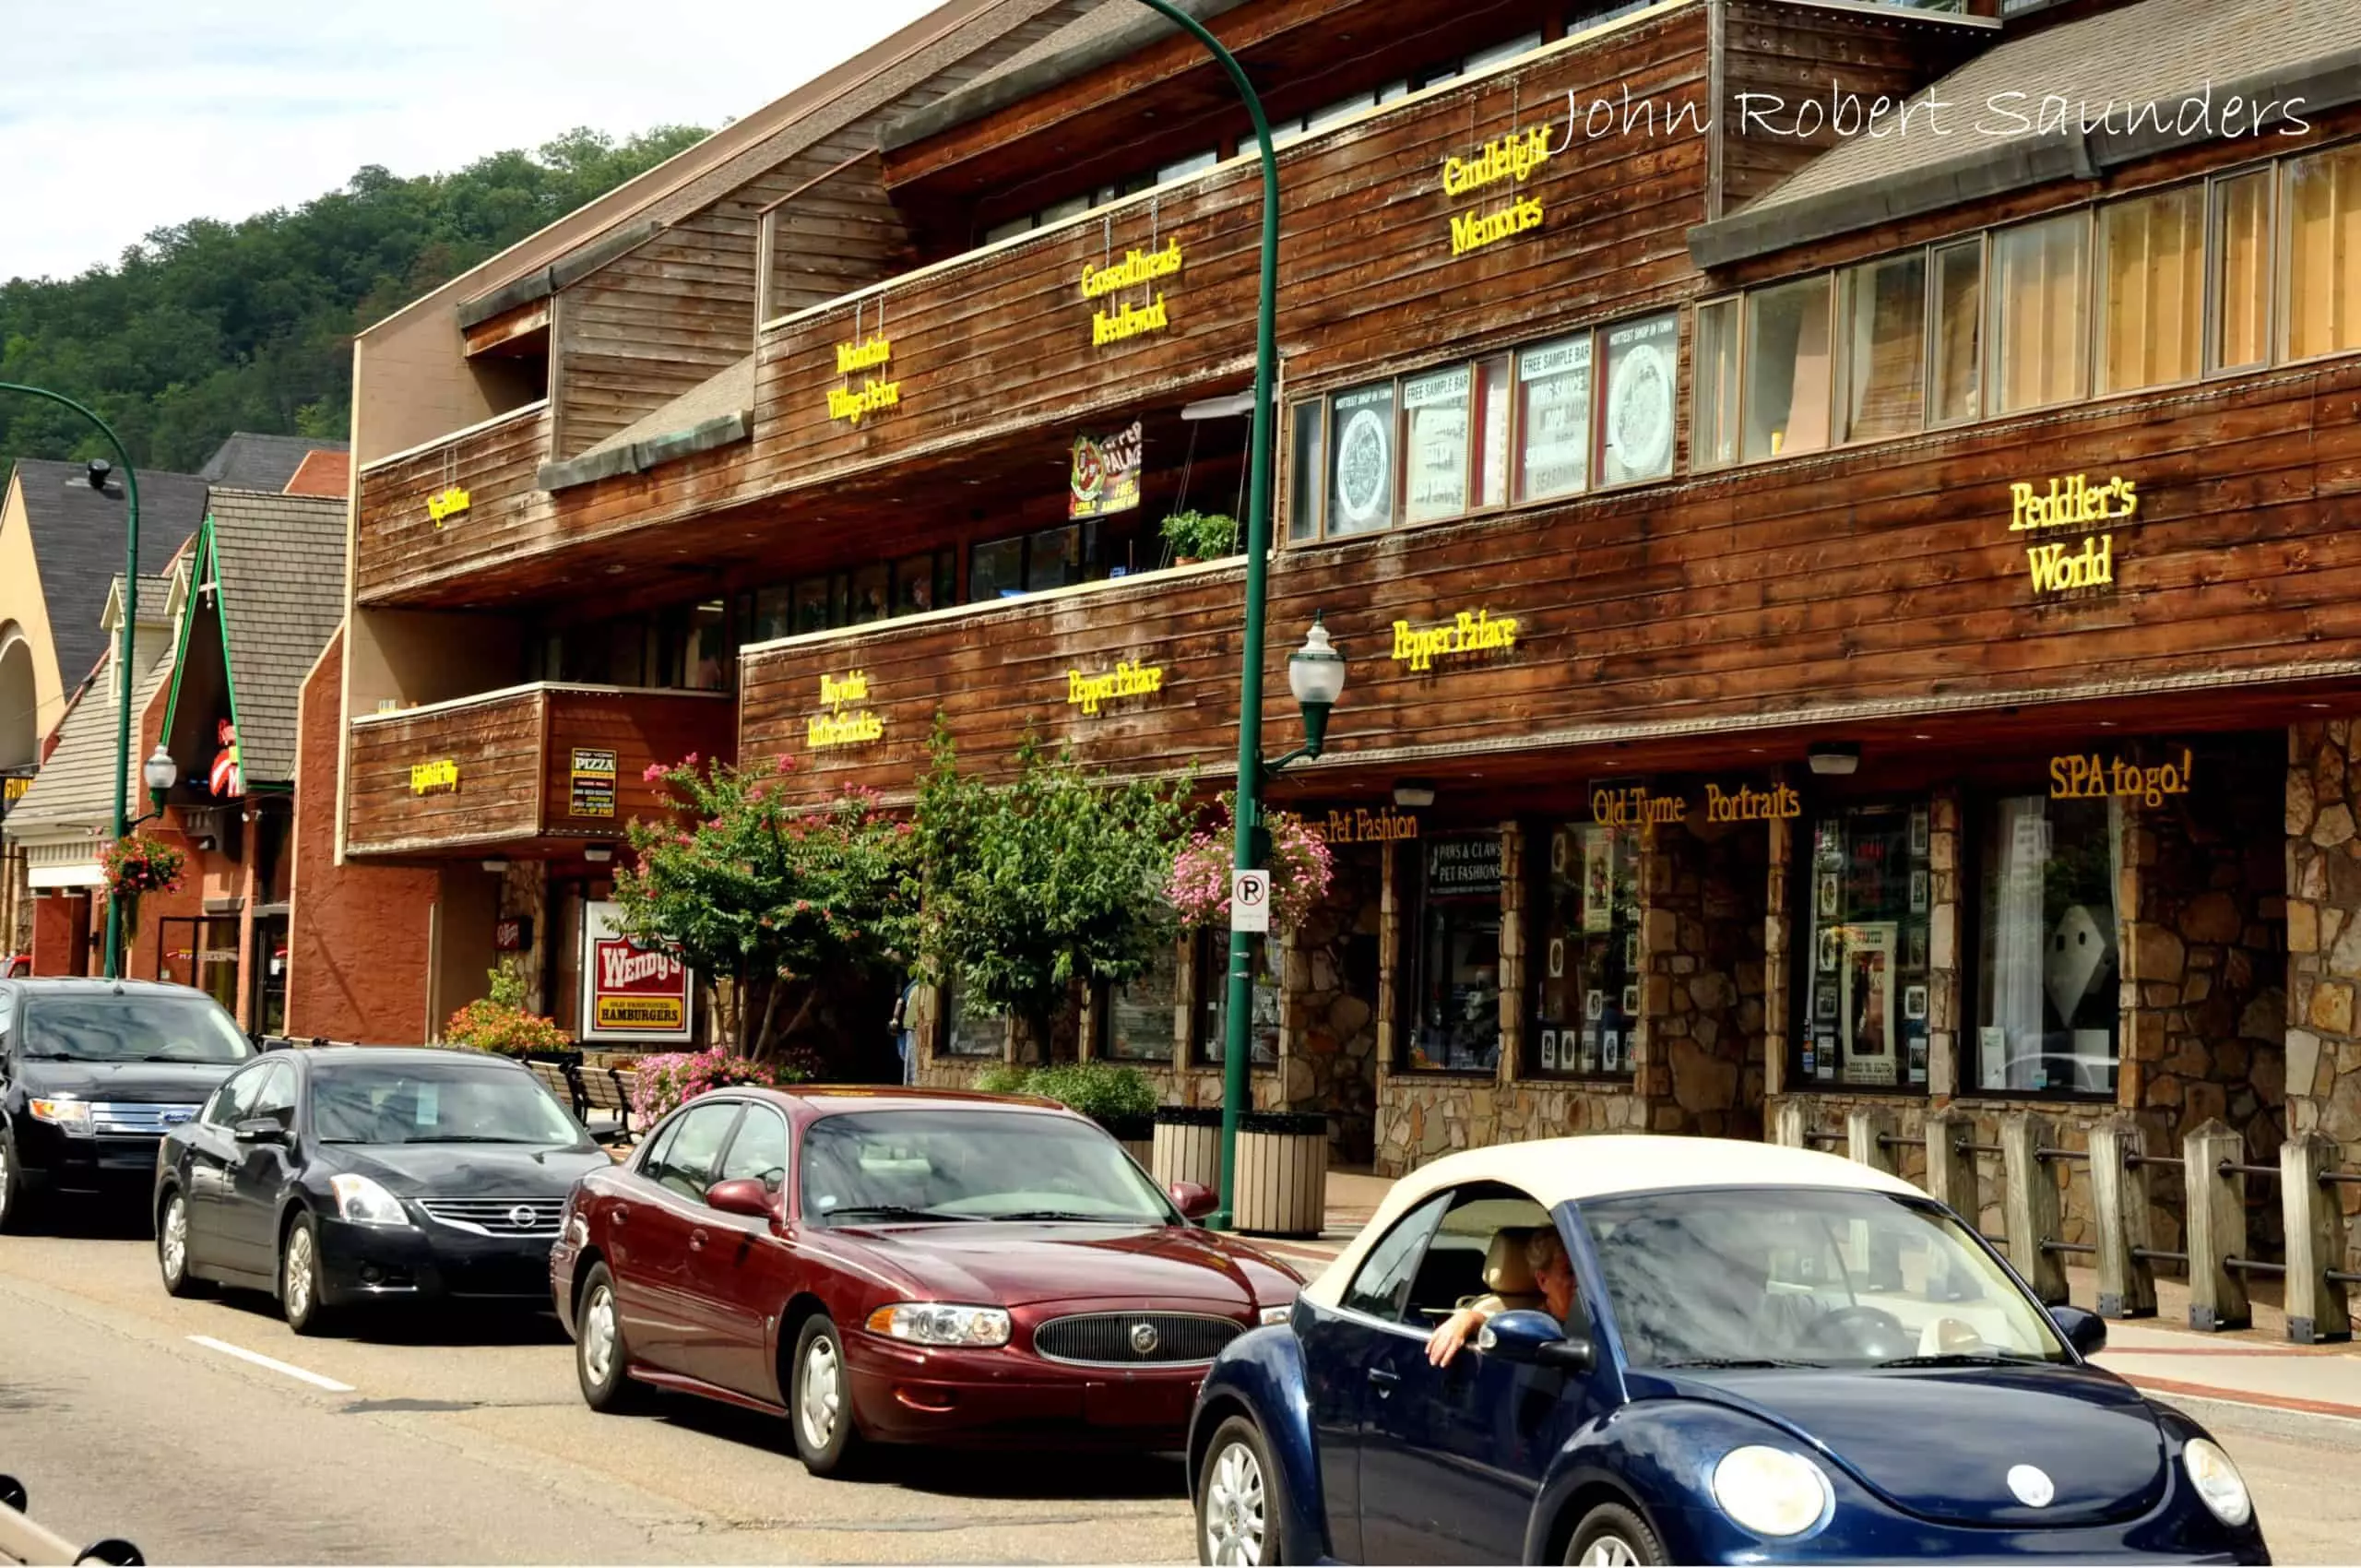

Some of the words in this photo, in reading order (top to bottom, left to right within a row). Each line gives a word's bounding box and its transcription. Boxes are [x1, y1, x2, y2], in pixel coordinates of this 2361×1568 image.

[1443, 123, 1554, 196] Candlelight
[1450, 196, 1545, 256] Memories
[1092, 291, 1168, 347] Needlework
[1634, 324, 1649, 341] SHOP
[1649, 323, 1656, 337] IN
[836, 332, 890, 374] Mountain
[1524, 355, 1542, 373] FREE
[1543, 348, 1573, 370] SAMPLE
[1574, 343, 1591, 362] BAR
[1406, 385, 1423, 400] FREE
[1425, 376, 1453, 398] SAMPLE
[1453, 373, 1469, 392] BAR
[2009, 472, 2138, 532] Peddler's
[2026, 533, 2114, 595] World
[1391, 619, 1454, 671] Pepper
[1454, 609, 1519, 652] Palace
[1068, 670, 1116, 716] Pepper
[1115, 659, 1163, 698] Palace
[575, 756, 615, 771] PIZZA
[2049, 752, 2108, 801] SPA
[1328, 809, 1353, 843] Pet
[1356, 805, 1418, 842] Fashion
[1593, 788, 1626, 827] Old
[1629, 786, 1687, 837] Tyme
[1704, 781, 1802, 823] Portraits
[1440, 844, 1462, 861] PAWS
[1471, 840, 1503, 859] CLAWS
[1440, 865, 1456, 883] PET
[1457, 863, 1501, 883] FASHIONS
[601, 947, 682, 987] Wendys
[601, 1008, 679, 1022] HAMBURGERS
